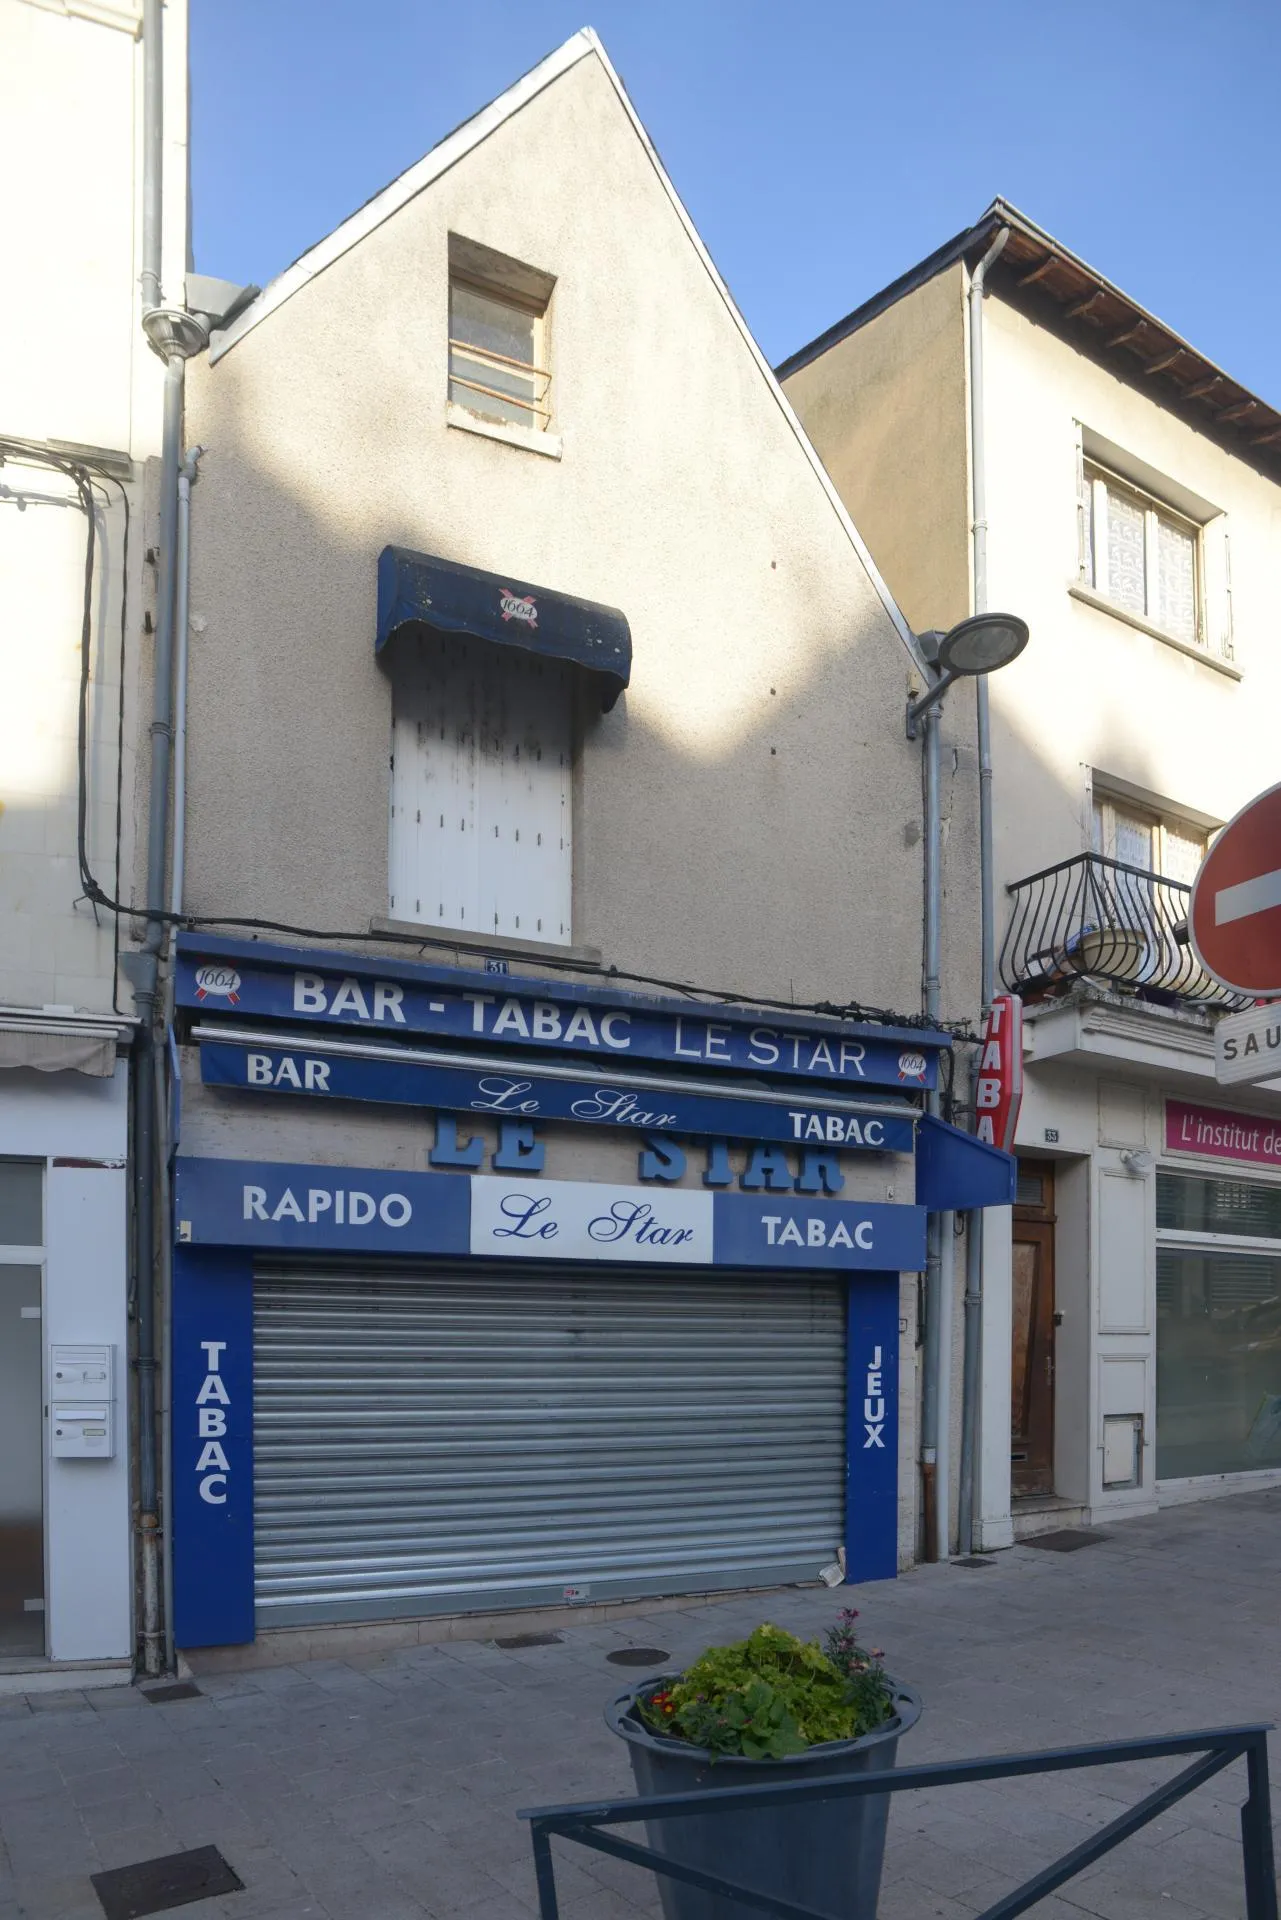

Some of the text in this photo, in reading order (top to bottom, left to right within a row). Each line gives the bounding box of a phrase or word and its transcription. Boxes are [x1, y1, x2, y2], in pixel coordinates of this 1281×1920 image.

[502, 598, 536, 619] 1664
[199, 968, 238, 990] 1664
[490, 962, 503, 974] 31
[293, 972, 406, 1023] BAR
[462, 992, 632, 1048] TABAC
[674, 1016, 733, 1062] LE
[747, 1026, 867, 1077] STAR
[900, 1055, 925, 1071] 1664
[246, 1053, 885, 1146] BAR Le Star TABAC
[428, 1114, 546, 1171] LE
[242, 1184, 413, 1228] RAPIDO
[492, 1193, 696, 1246] Le Star
[760, 1215, 874, 1250] TABAC
[863, 1345, 886, 1449] JEUX
[195, 1341, 232, 1505] TABAC
